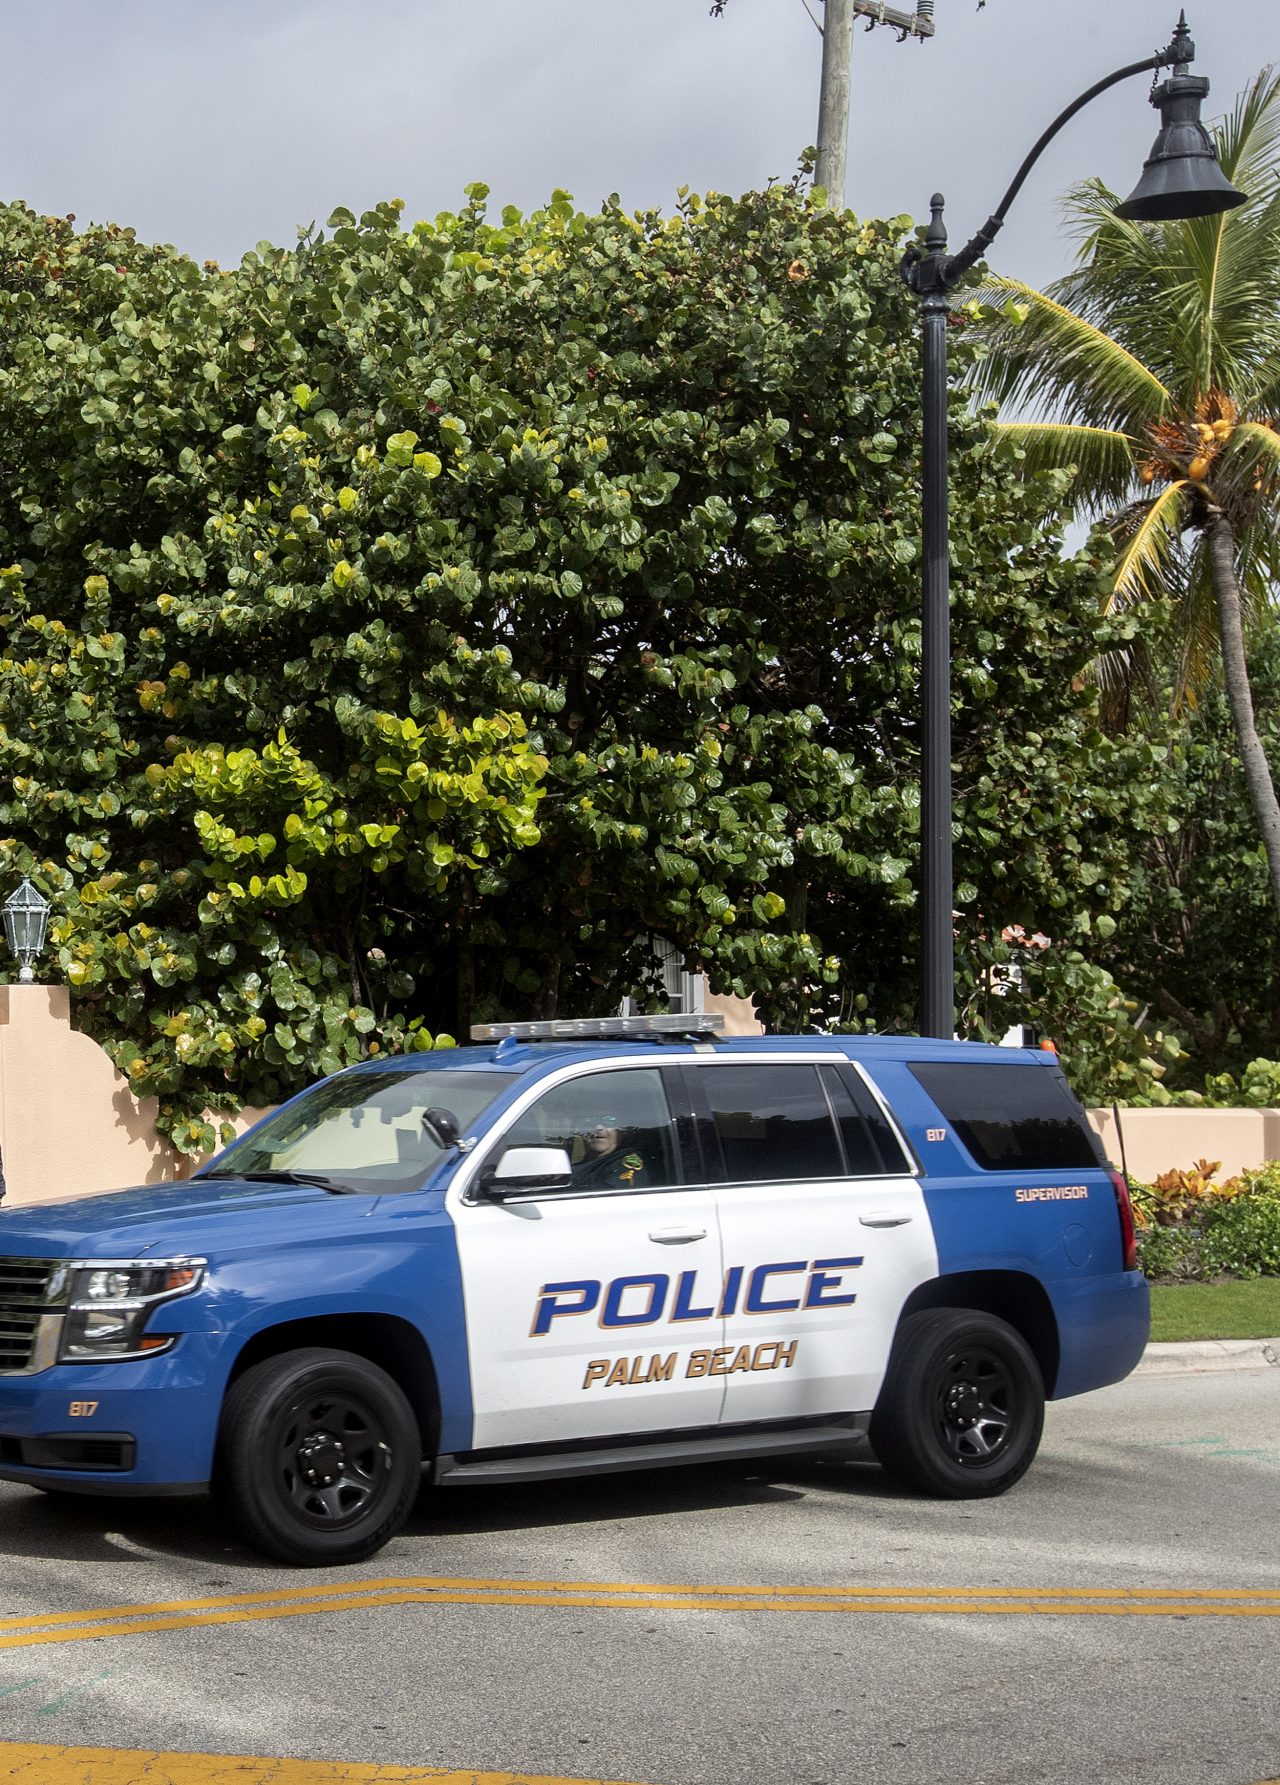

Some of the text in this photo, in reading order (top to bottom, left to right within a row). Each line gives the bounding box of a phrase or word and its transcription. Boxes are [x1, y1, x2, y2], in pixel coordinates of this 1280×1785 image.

[926, 1128, 946, 1142] 817
[1015, 1186, 1088, 1202] SUPERVISOR
[528, 1256, 864, 1337] POLICE
[582, 1340, 798, 1389] PALM BEACH
[68, 1401, 99, 1417] 817
